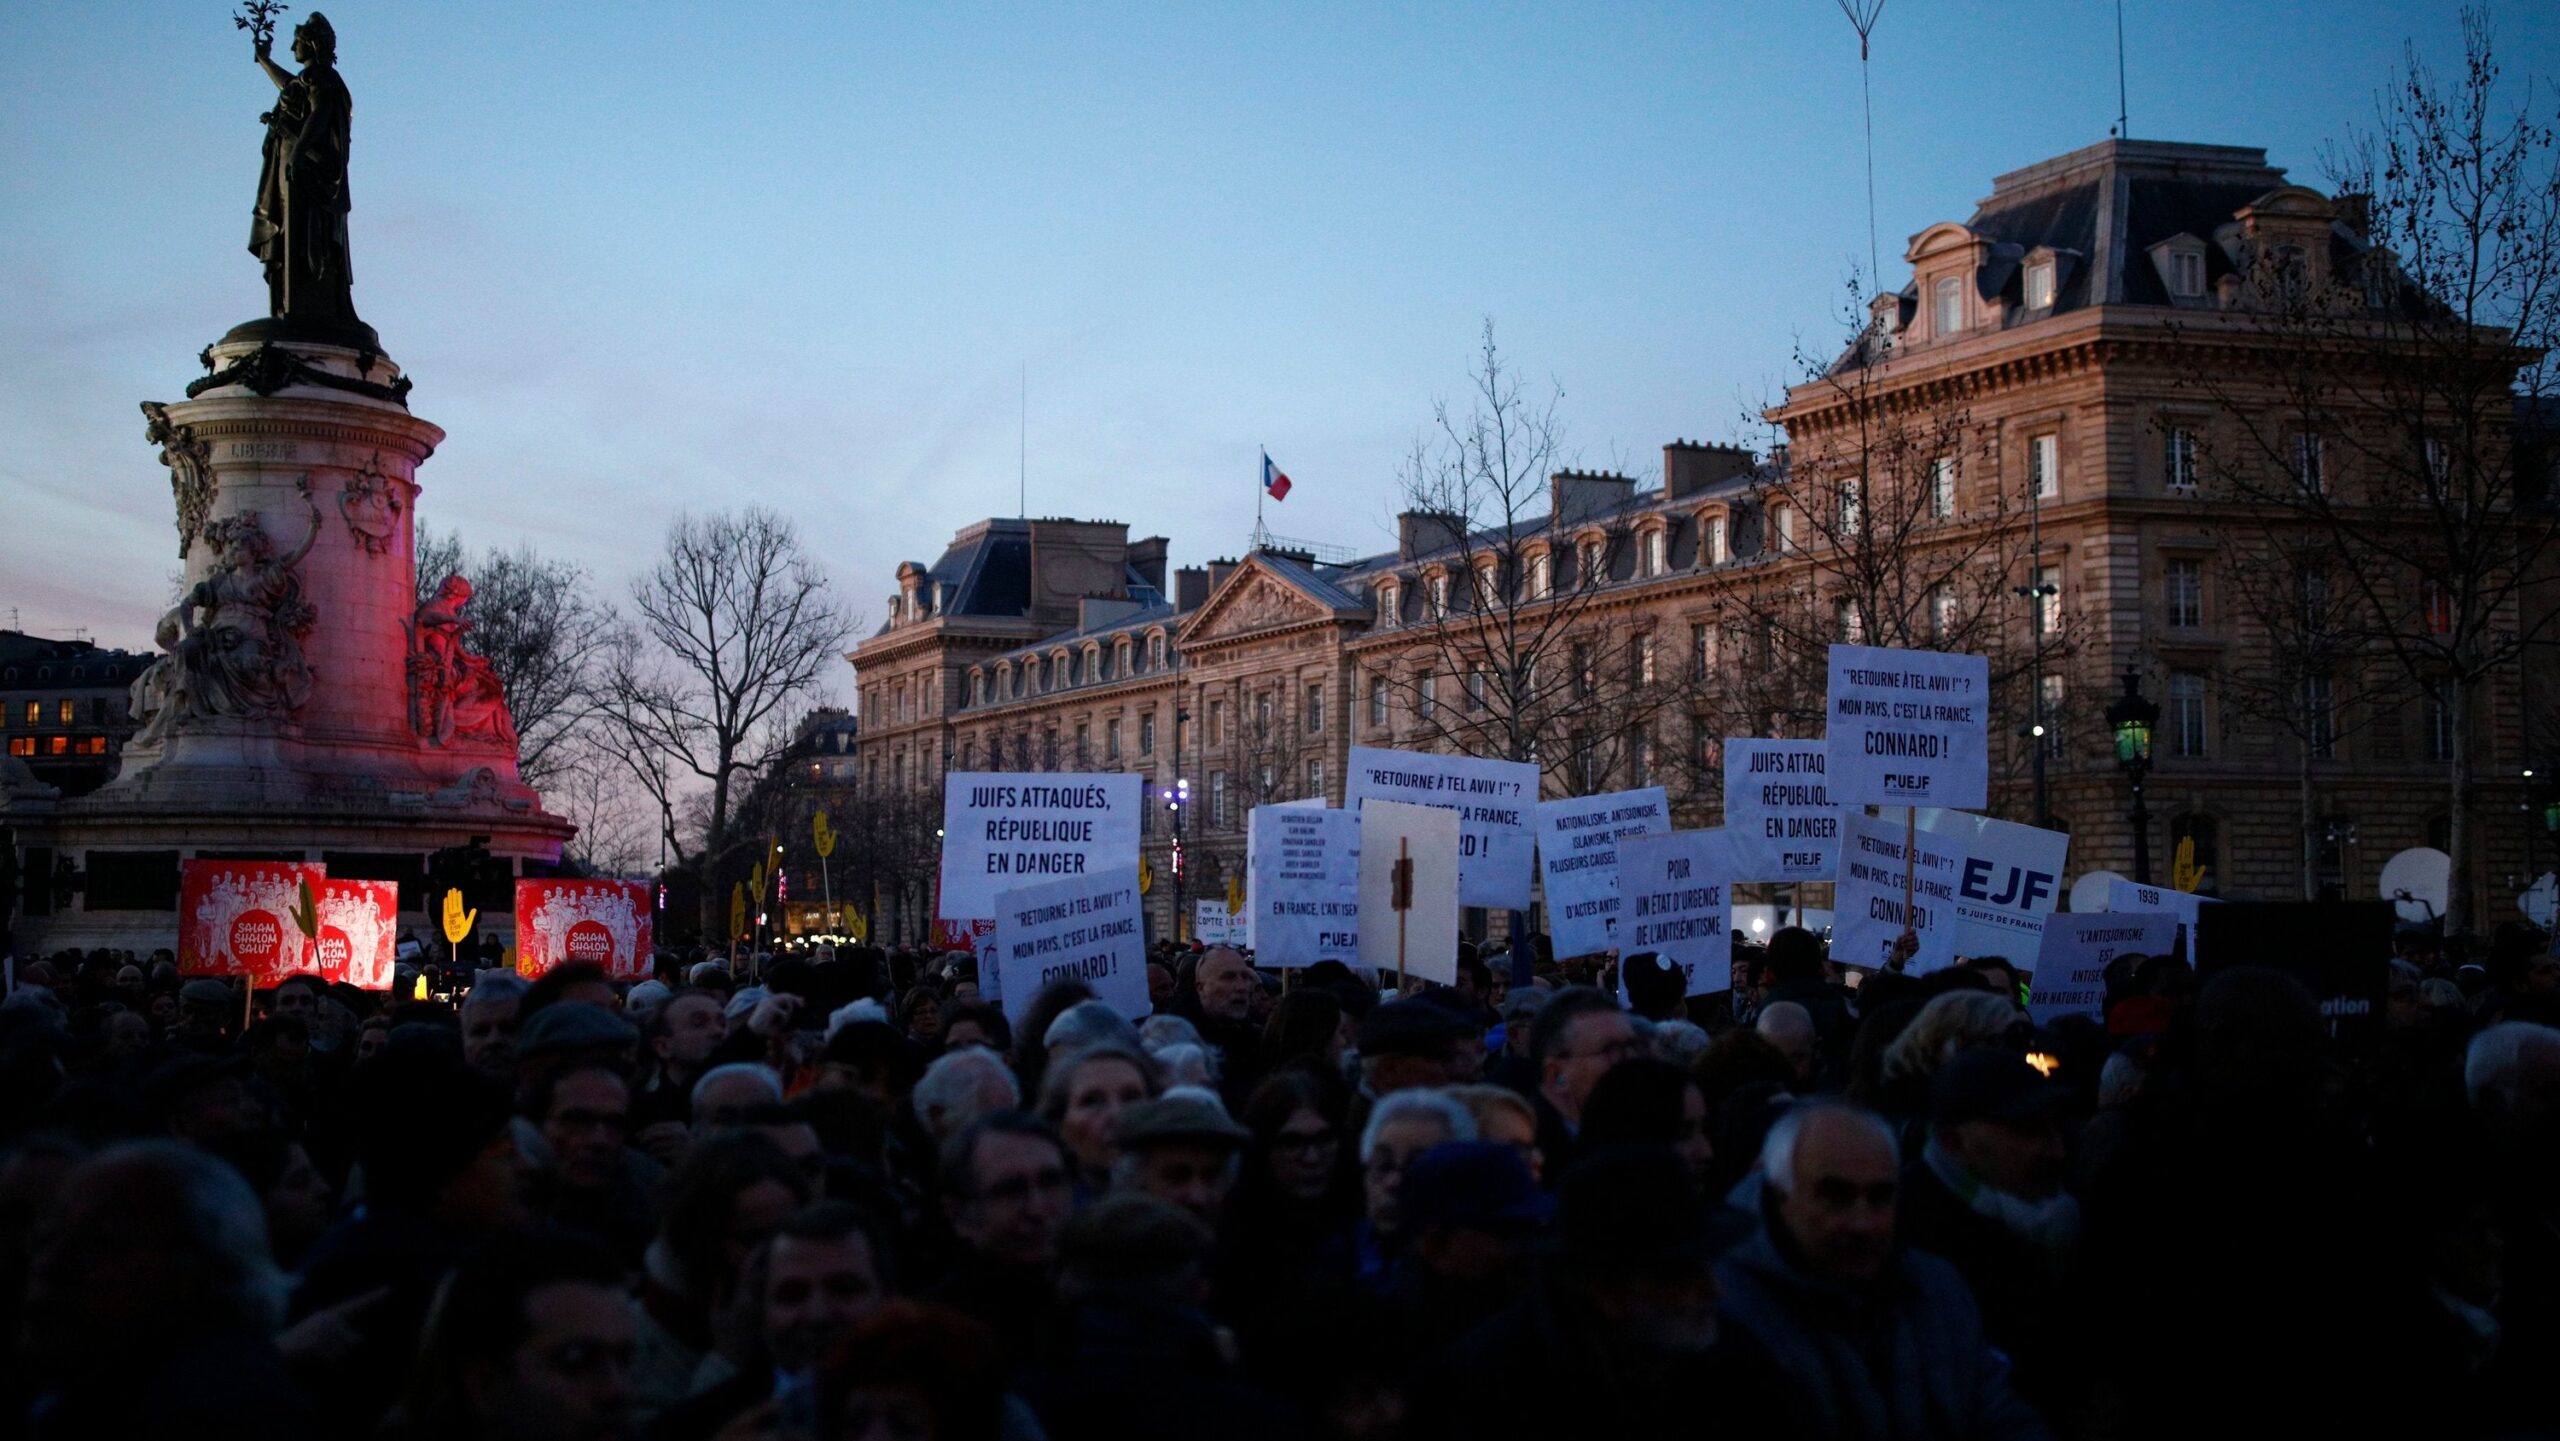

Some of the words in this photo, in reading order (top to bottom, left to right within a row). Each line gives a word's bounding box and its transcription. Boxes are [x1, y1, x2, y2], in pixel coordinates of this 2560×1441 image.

[1844, 668, 1900, 687] "RETOURNE
[1910, 674, 1926, 690] TEL
[1929, 676, 1949, 691] AVIV
[1838, 700, 1861, 715] MON
[1865, 700, 1890, 719] PAYS,
[1894, 703, 1918, 719] C'EST
[1920, 705, 1931, 720] LA
[1934, 706, 1974, 724] FRANCE,
[1865, 731, 1938, 758] CONNARD
[1943, 736, 1948, 758] !
[1750, 752, 1784, 773] JUIFS
[1787, 754, 1825, 774] ATTAQ
[1366, 769, 1434, 789] "RETOURNE
[1447, 776, 1466, 791] TEL
[1470, 779, 1496, 794] AVIV
[1898, 774, 1930, 790] UEJF
[969, 787, 1016, 808] JUIFS
[1021, 784, 1110, 810] ATTAQUÉS,
[1474, 807, 1522, 827] FRANCE,
[986, 817, 1092, 842] RÉPUBLIQUE
[1766, 818, 1782, 838] EN
[1788, 818, 1836, 838] DANGER
[1794, 853, 1821, 865] UEJF
[1857, 835, 1901, 860] "RETOURNE
[1922, 852, 1938, 869] AVIV
[987, 853, 1008, 873] EN
[1016, 853, 1085, 873] DANGER
[1550, 857, 1589, 873] PLUSIEURS
[1668, 858, 1690, 880] POUR
[1851, 862, 1869, 880] MON
[1871, 866, 1890, 887] PAYS,
[1914, 878, 1923, 892] LA
[1960, 856, 2054, 910] EJF
[1636, 896, 1649, 917] UN
[1652, 891, 1671, 915] ÉTAT
[1673, 886, 1720, 912] D'URGENCE
[2138, 889, 2159, 905] 1939
[1014, 903, 1066, 927] "RETOURNE
[1076, 899, 1091, 914] TEL
[1094, 894, 1112, 910] AVIV
[1273, 902, 1285, 915] EN
[1566, 901, 1597, 919] D'ACTES
[1969, 910, 1994, 921] JUIFS
[1996, 916, 2007, 924] DE
[238, 922, 275, 934] SALAM
[572, 932, 607, 942] SALAM
[1636, 925, 1648, 946] DE
[1650, 916, 1720, 944] L'ANTISÉMITISME
[234, 933, 278, 944] SHALOM
[322, 938, 345, 949] LAM
[570, 942, 610, 952] SHALOM
[1013, 942, 1034, 960] MON
[1037, 936, 1061, 954] PAYS,
[1064, 930, 1086, 948] C'EST
[1088, 928, 1099, 942] LA
[1101, 918, 1137, 939] FRANCE,
[239, 944, 272, 954] SALUT
[2098, 948, 2114, 962] EST
[323, 958, 341, 969] LUT
[2031, 991, 2048, 1004] PAR
[2050, 991, 2083, 1004] NATURE
[2085, 991, 2096, 1004] ET
